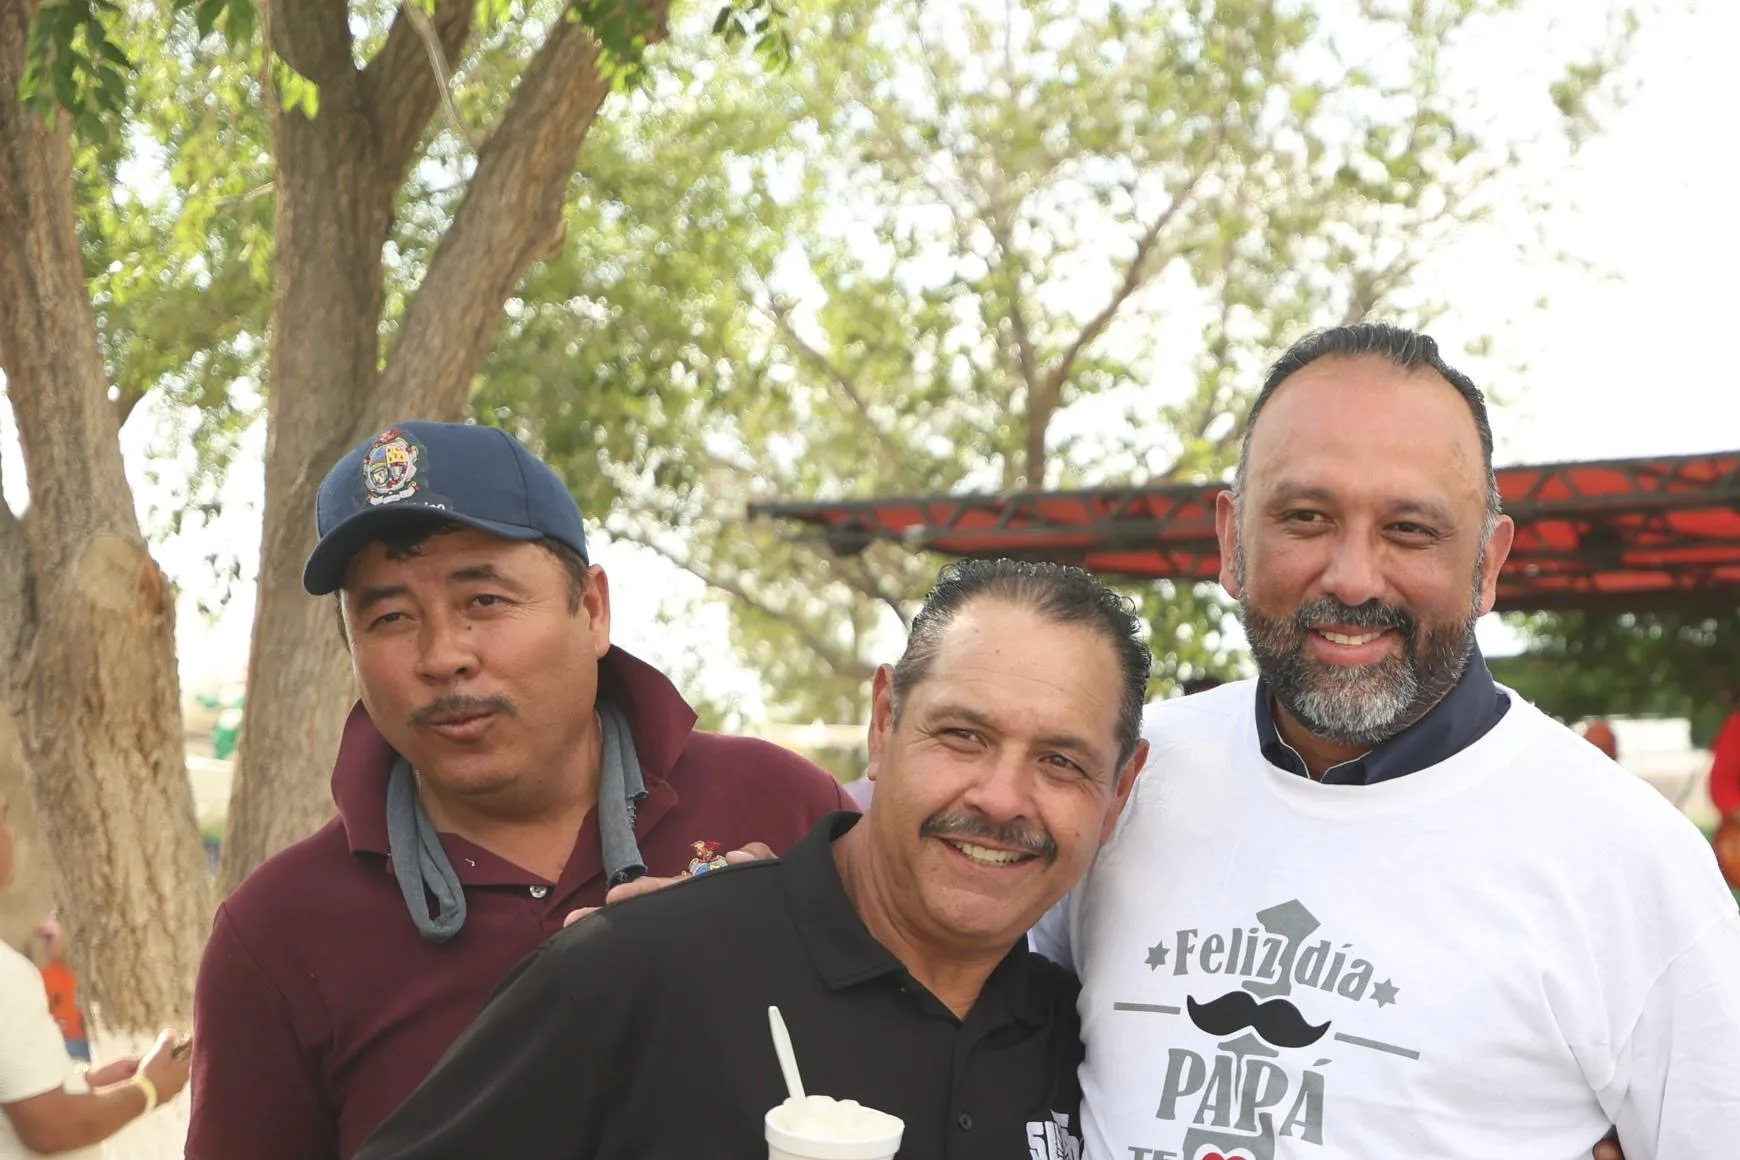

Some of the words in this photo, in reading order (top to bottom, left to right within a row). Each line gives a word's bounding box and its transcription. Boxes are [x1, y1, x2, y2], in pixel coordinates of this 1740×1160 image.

[1173, 927, 1286, 979] Feliz
[1295, 940, 1375, 1002] día
[1155, 1048, 1333, 1146] PAPÁ
